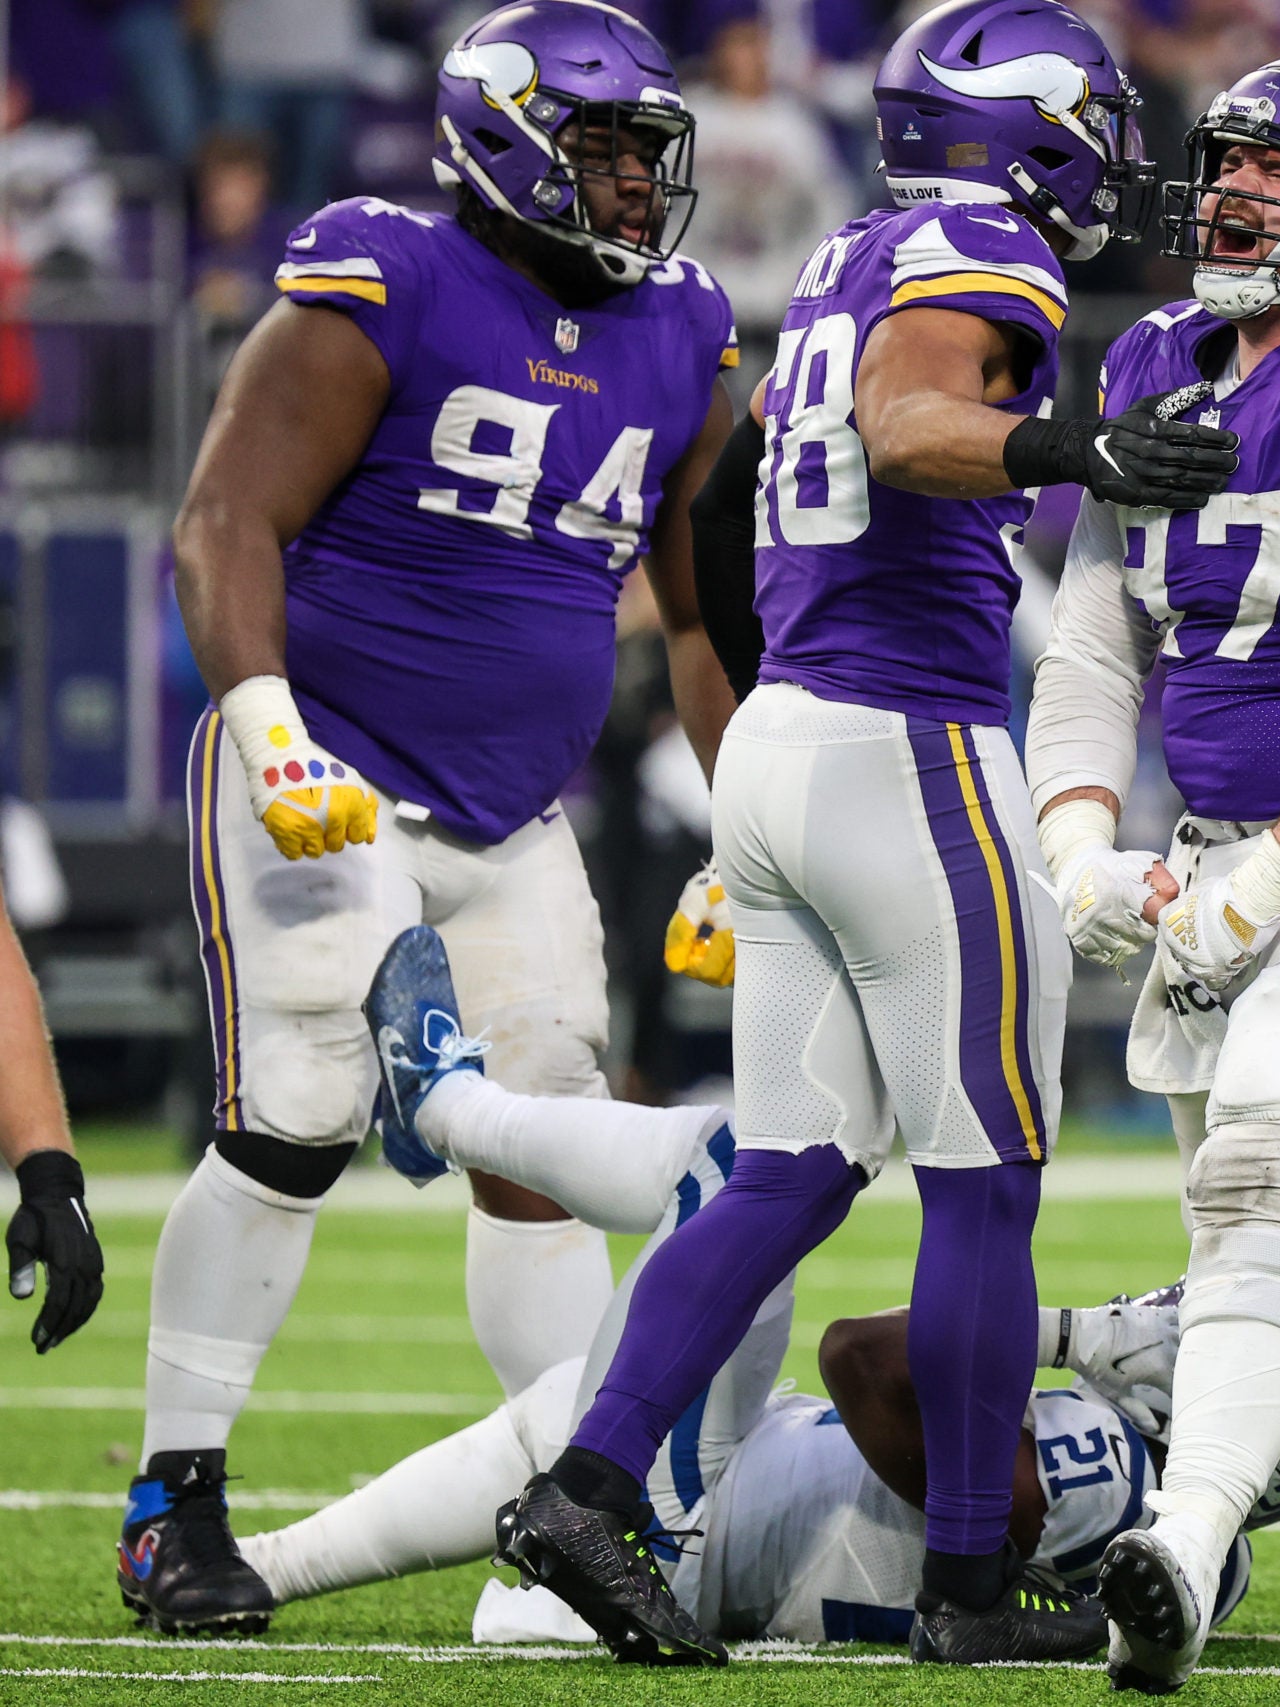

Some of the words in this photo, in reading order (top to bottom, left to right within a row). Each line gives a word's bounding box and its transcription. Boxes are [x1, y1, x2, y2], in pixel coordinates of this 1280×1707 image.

[909, 187, 943, 200] LOVE
[525, 356, 599, 394] Vikings
[416, 384, 654, 571] 94
[1037, 1426, 1114, 1500] 21
